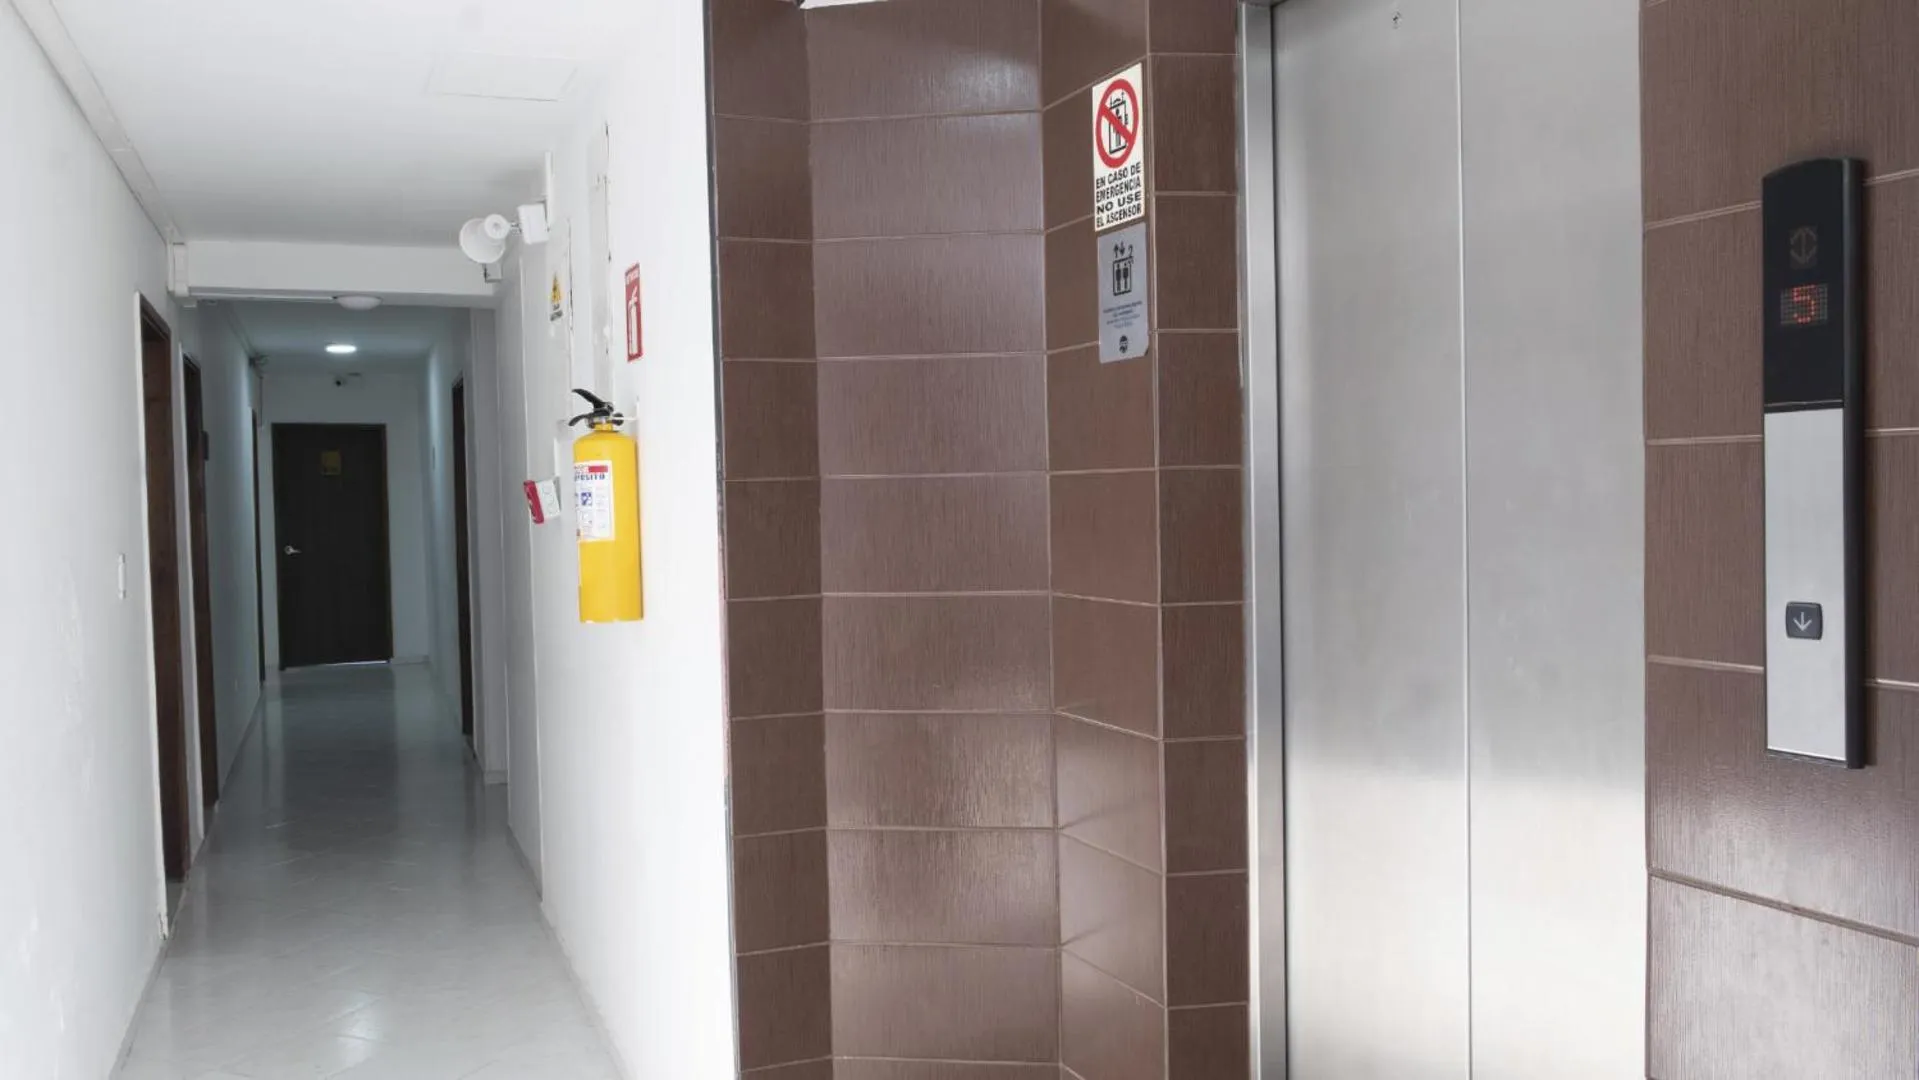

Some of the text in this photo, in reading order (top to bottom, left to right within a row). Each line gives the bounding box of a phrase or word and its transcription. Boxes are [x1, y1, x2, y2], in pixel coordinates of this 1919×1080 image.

[1096, 162, 1141, 189] EN CASO DE
[1096, 175, 1141, 203] EMERGENCIA
[1097, 191, 1141, 215] NO USE
[1097, 203, 1141, 228] EL ASCENSOR
[1792, 284, 1816, 324] 5
